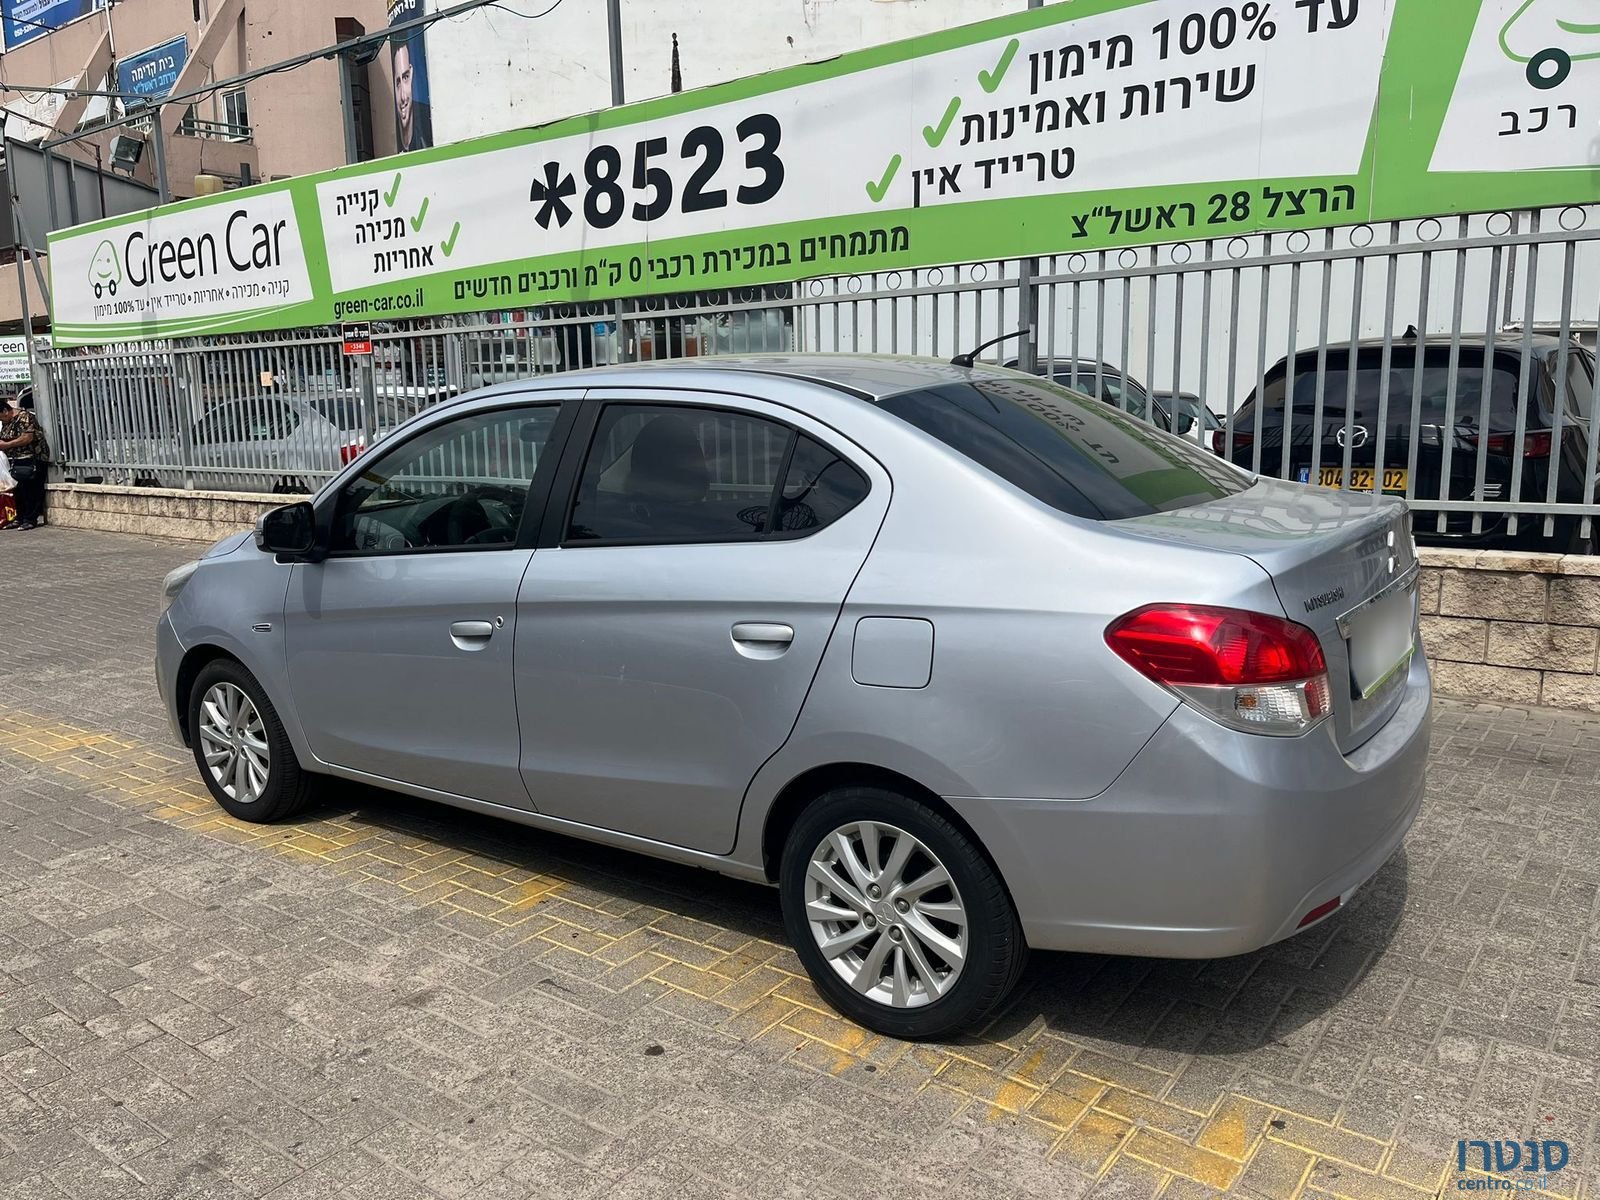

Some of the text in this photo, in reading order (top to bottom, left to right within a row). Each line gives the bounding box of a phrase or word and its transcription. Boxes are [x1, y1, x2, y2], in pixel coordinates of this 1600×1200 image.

[1029, 0, 1359, 95] עד 100% מימון
[159, 56, 175, 72] בית
[960, 64, 1256, 146] שירות ואמינות
[1498, 104, 1577, 136] רכב
[911, 147, 1075, 208] טרייד אין
[337, 189, 379, 217] קנייה
[1207, 191, 1250, 224] 28
[1262, 184, 1356, 218] הרצל
[355, 217, 406, 244] מכירה
[800, 226, 909, 262] מתמחים
[125, 210, 286, 287] Green Car
[374, 245, 434, 273] אחריות
[702, 241, 791, 274] במכירת
[518, 267, 577, 293] ורכבים
[629, 256, 642, 282] 0
[648, 253, 695, 280] רכבי
[94, 279, 290, 320] קניה מכירה אחריות טרייד אין עד 100% מימון
[454, 275, 512, 299] חדשים
[334, 288, 424, 319] green-car.co.il
